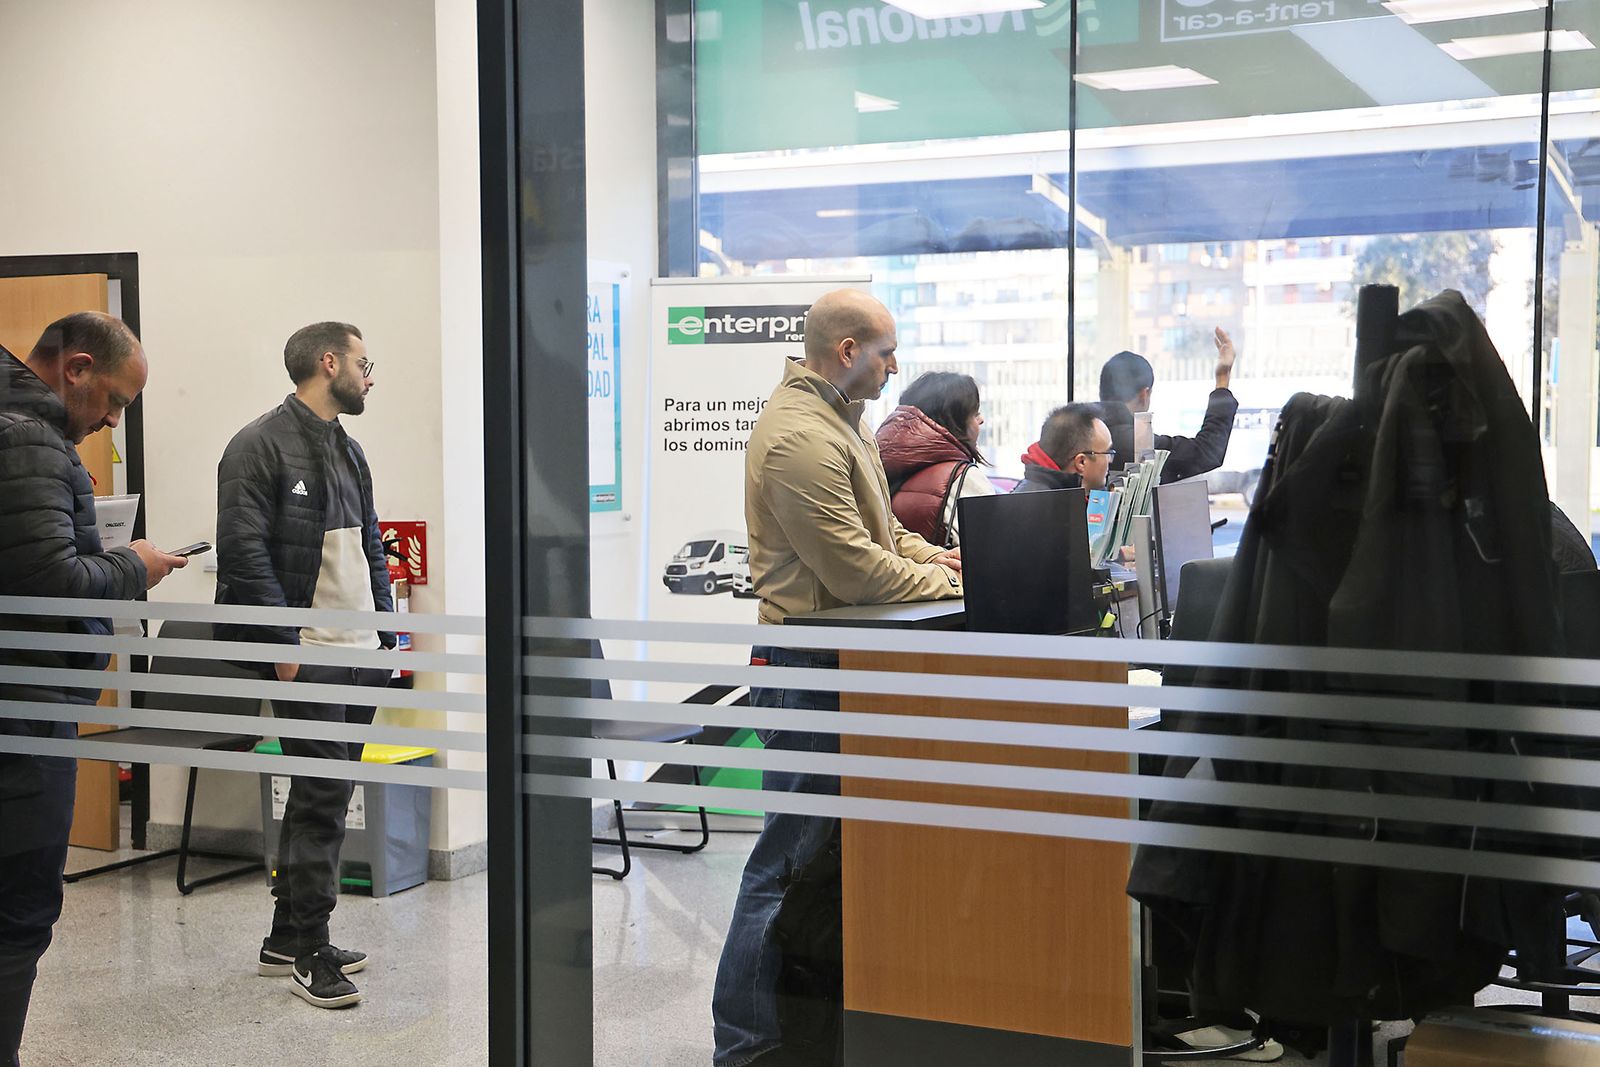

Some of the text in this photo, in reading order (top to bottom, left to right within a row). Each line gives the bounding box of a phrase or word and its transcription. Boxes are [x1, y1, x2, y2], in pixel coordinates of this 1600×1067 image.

[664, 398, 700, 411] Para
[707, 400, 726, 411] un
[664, 418, 730, 431] abrimos
[664, 438, 687, 451] los
